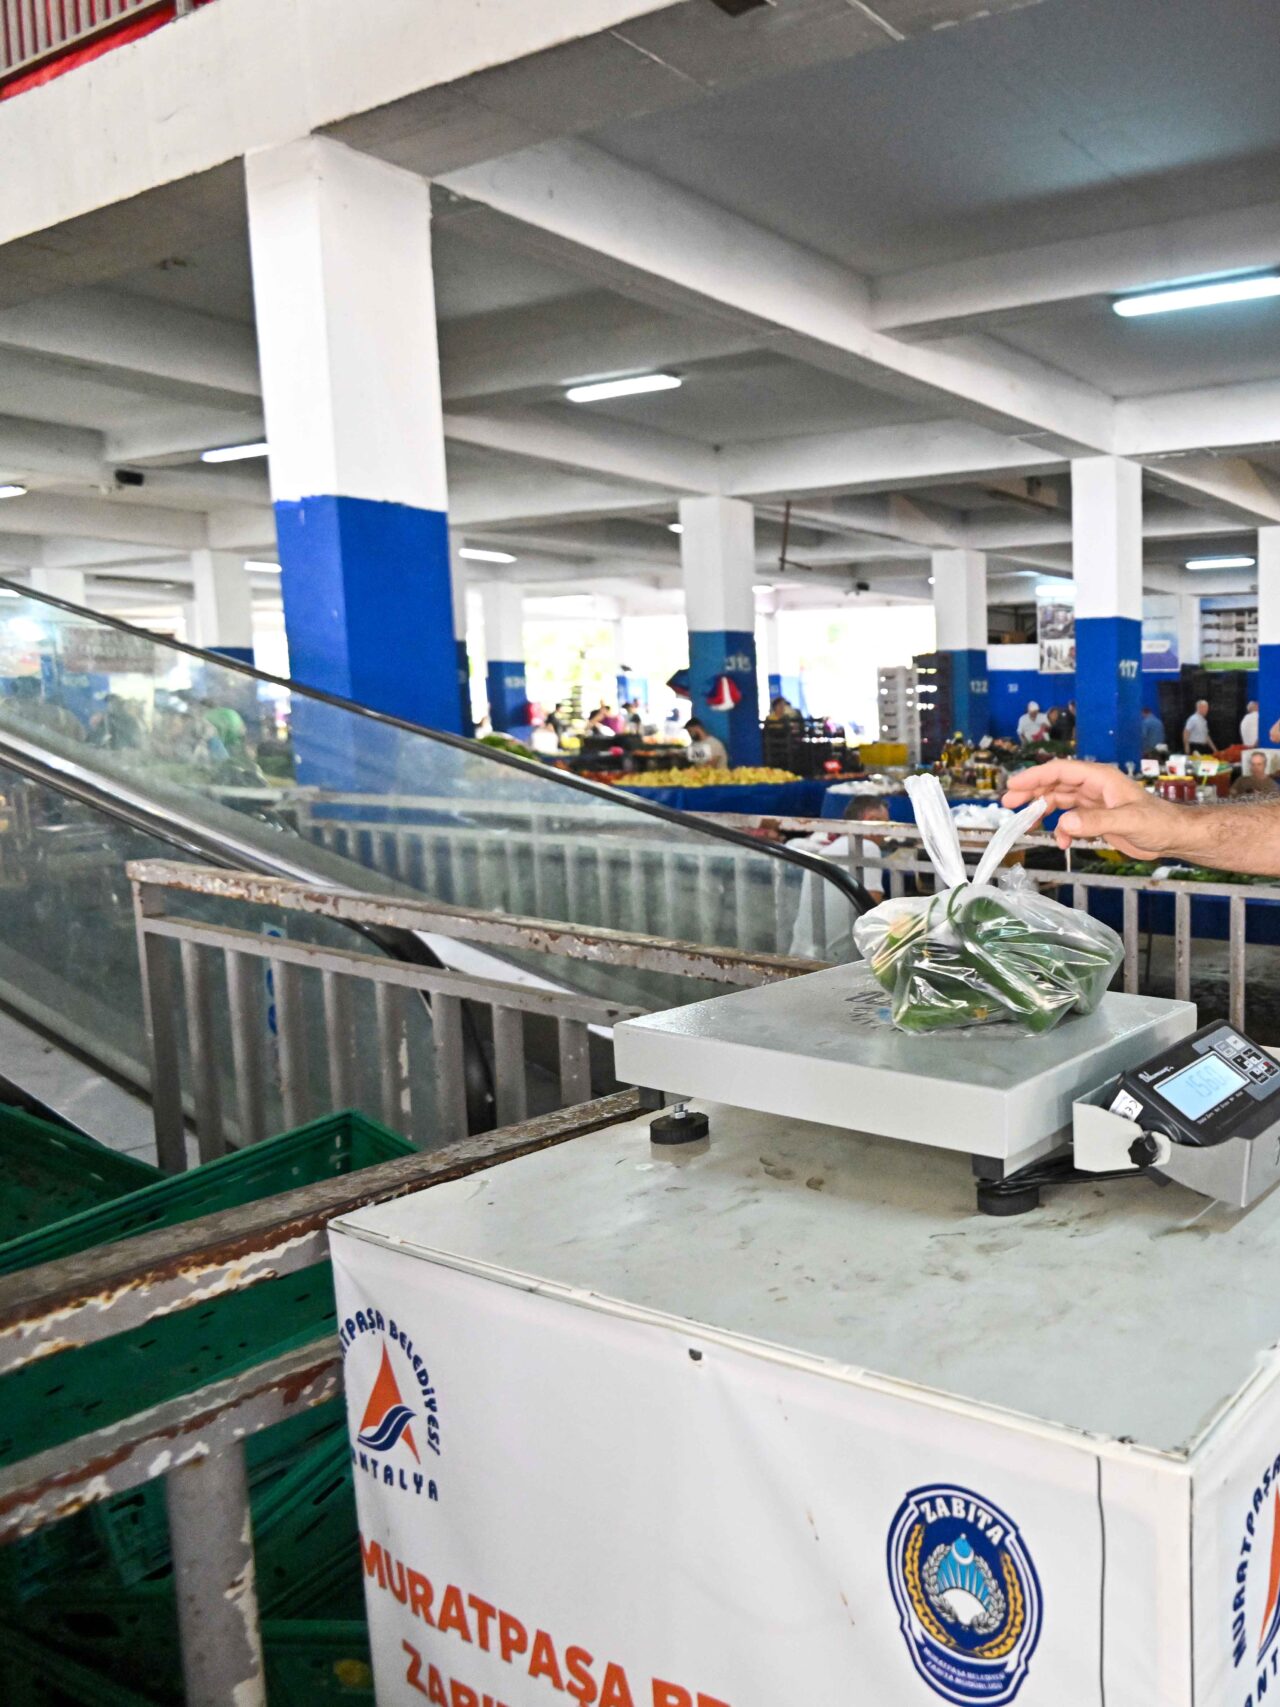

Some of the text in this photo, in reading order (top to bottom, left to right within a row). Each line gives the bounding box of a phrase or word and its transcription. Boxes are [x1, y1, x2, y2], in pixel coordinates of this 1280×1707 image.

[1119, 659, 1139, 678] 117
[920, 1497, 1004, 1545] ZABITA
[359, 1535, 634, 1707] MURATPAŞA
